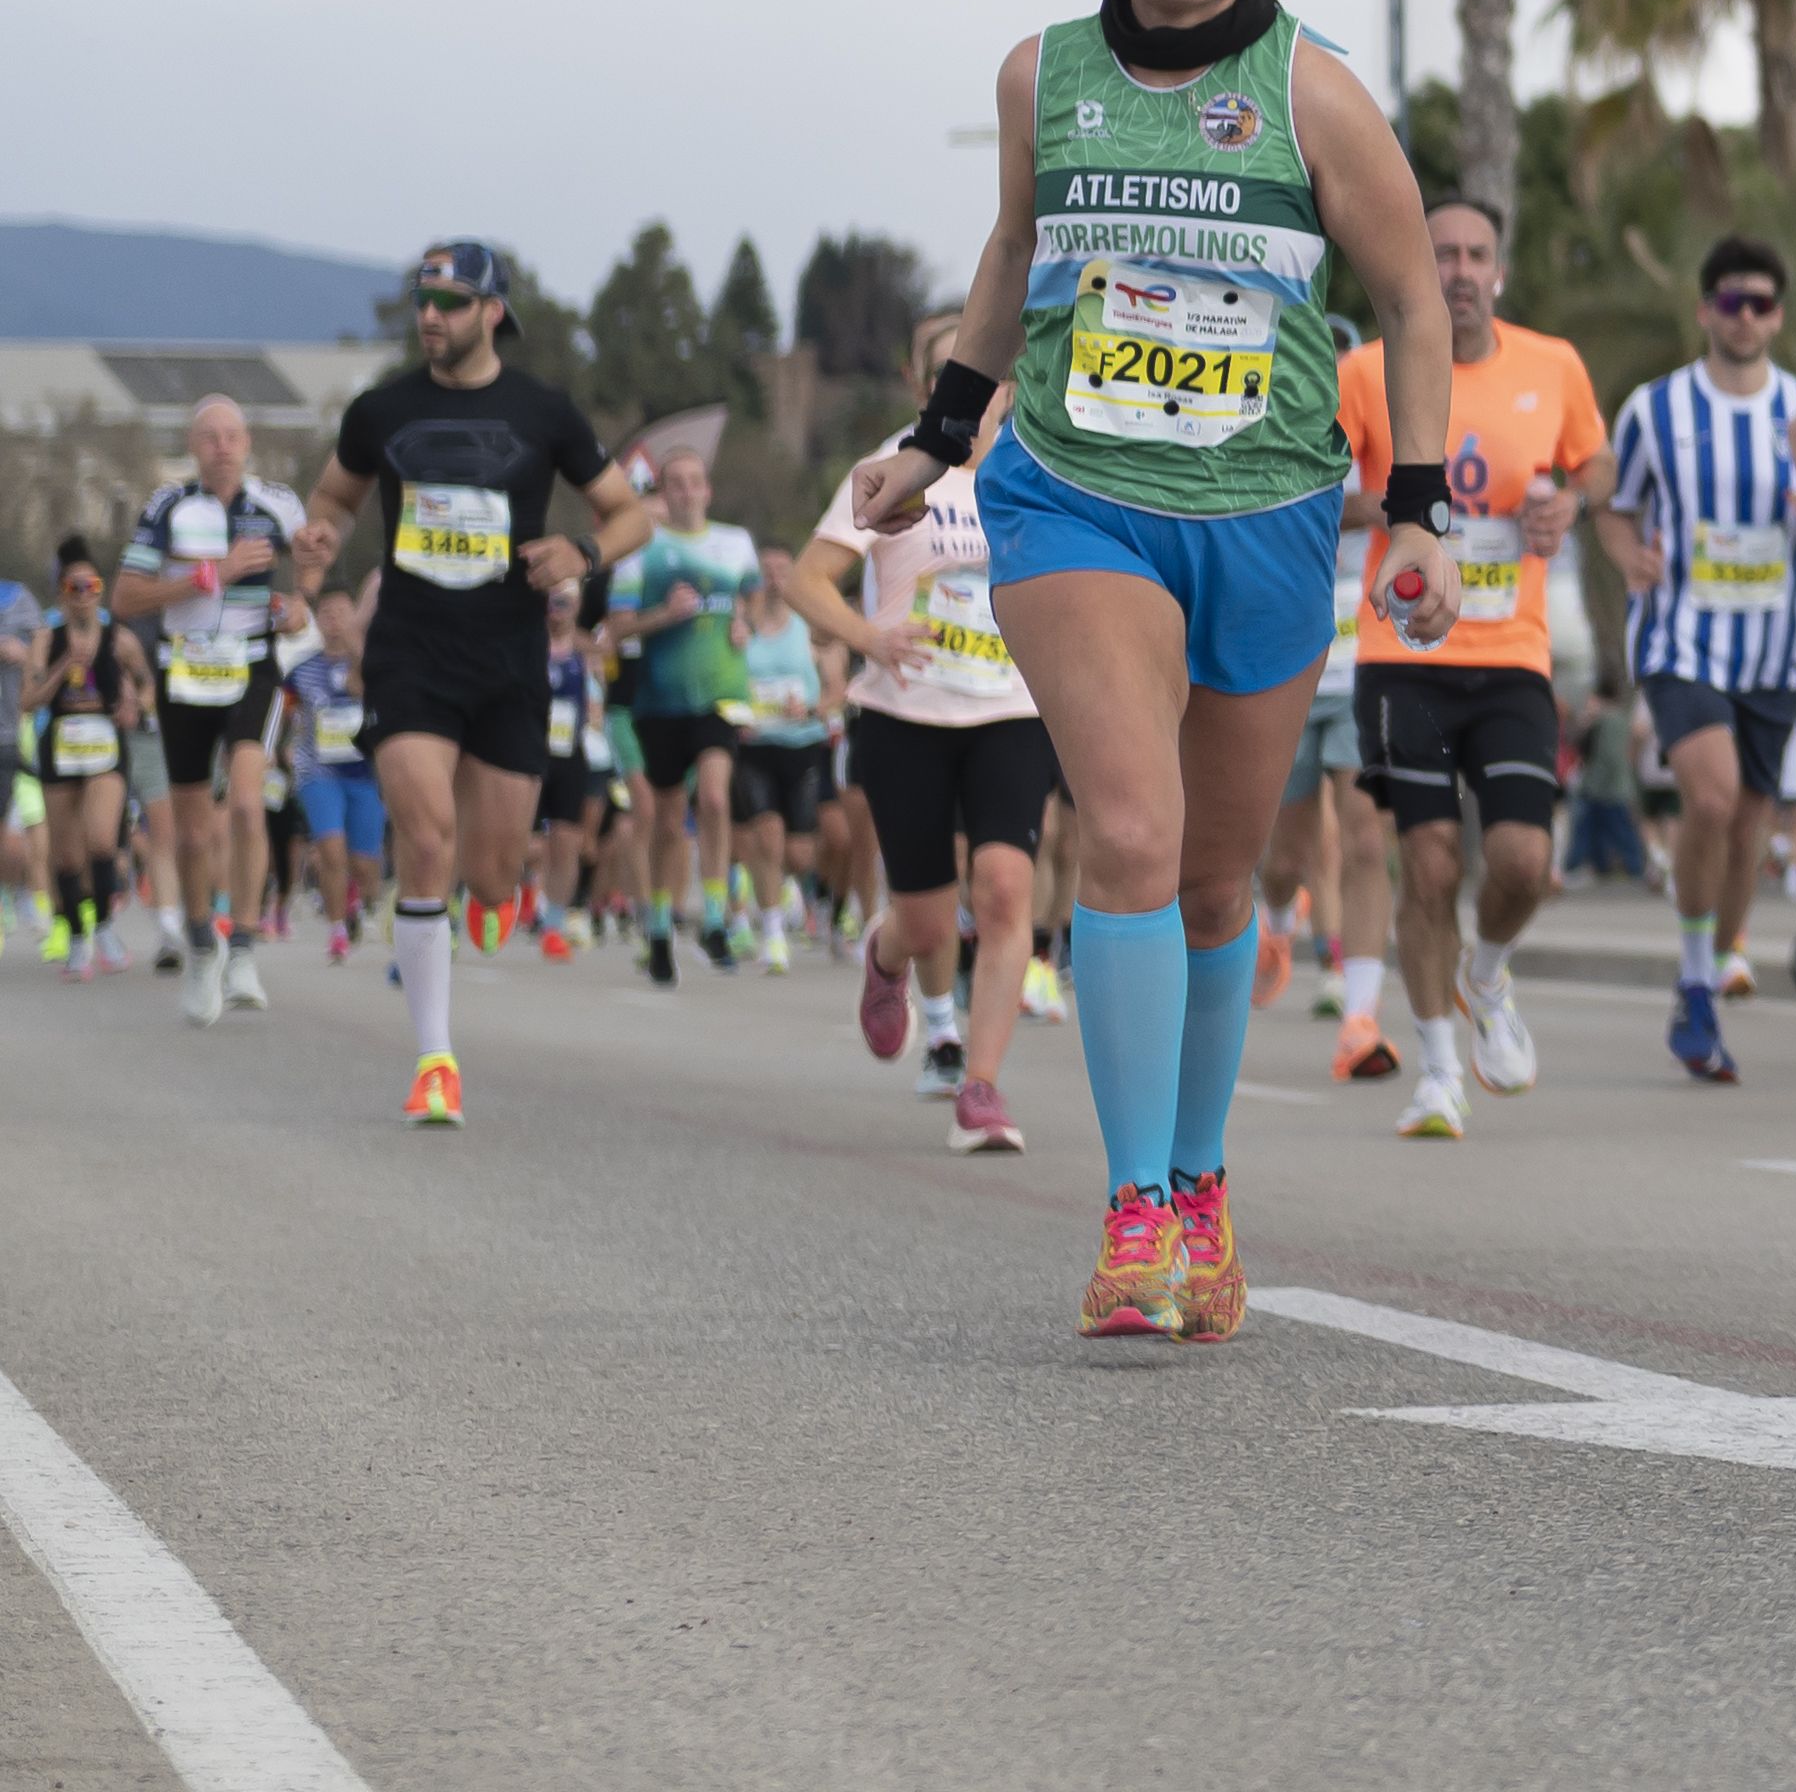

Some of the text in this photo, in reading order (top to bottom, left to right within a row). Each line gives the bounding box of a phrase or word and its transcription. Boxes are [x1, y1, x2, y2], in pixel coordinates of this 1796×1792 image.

[1065, 174, 1241, 215] ATLETISMO
[1044, 222, 1268, 264] TORREMOLINOS
[1112, 309, 1173, 330] TotalEnergies
[1100, 340, 1233, 395] F2021
